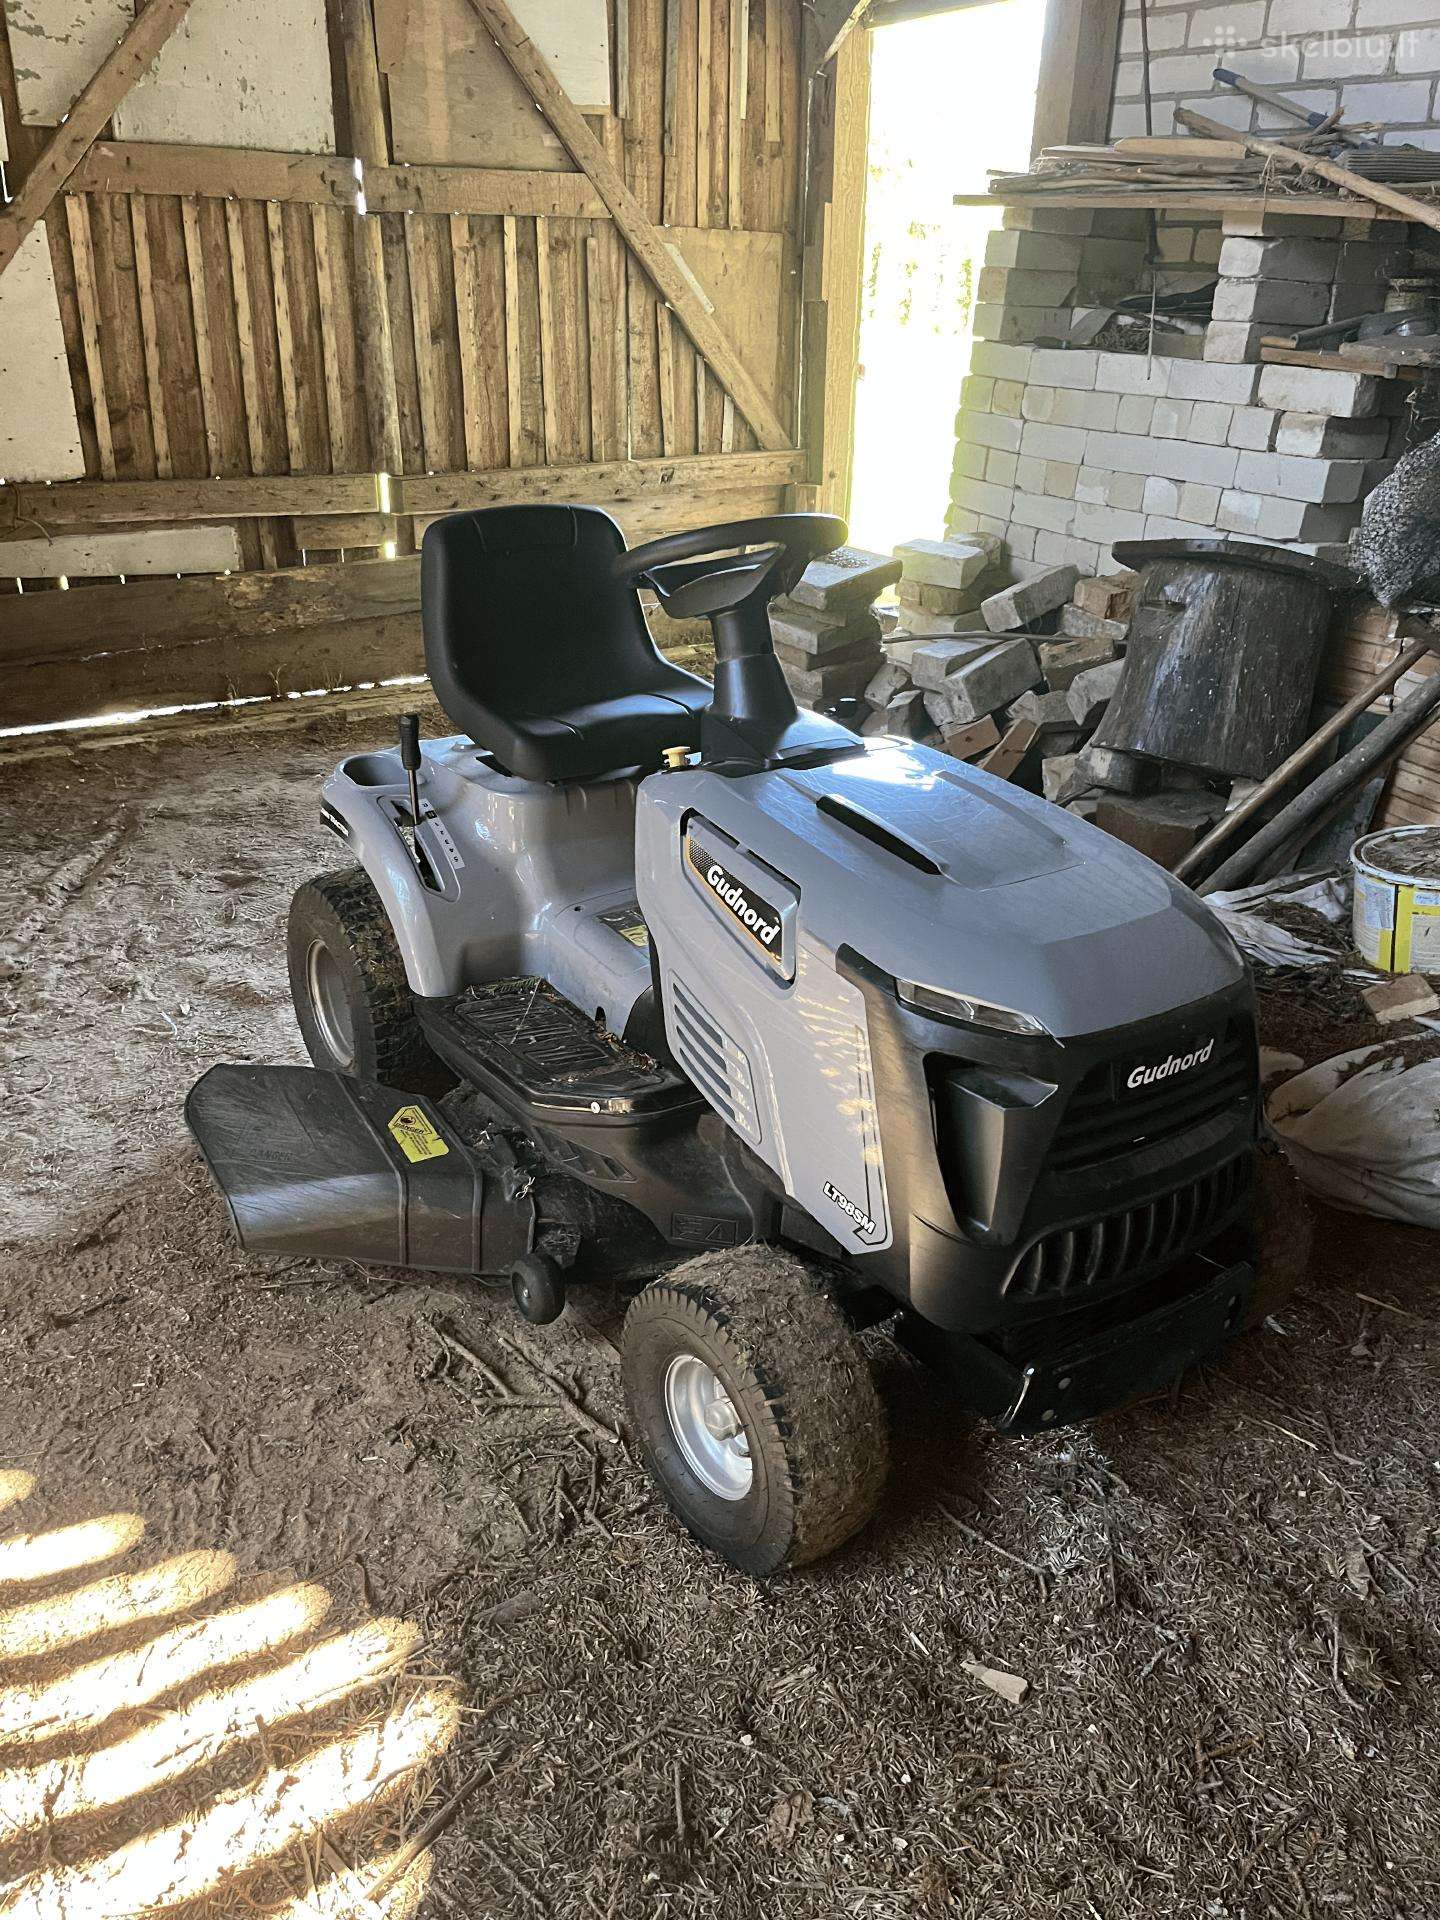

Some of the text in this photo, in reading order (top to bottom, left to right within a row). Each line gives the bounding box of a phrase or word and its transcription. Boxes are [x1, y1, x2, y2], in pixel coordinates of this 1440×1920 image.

[707, 864, 781, 945] Gudnord
[1127, 1038, 1215, 1089] Gudnord
[823, 1181, 877, 1235] LT98SM
